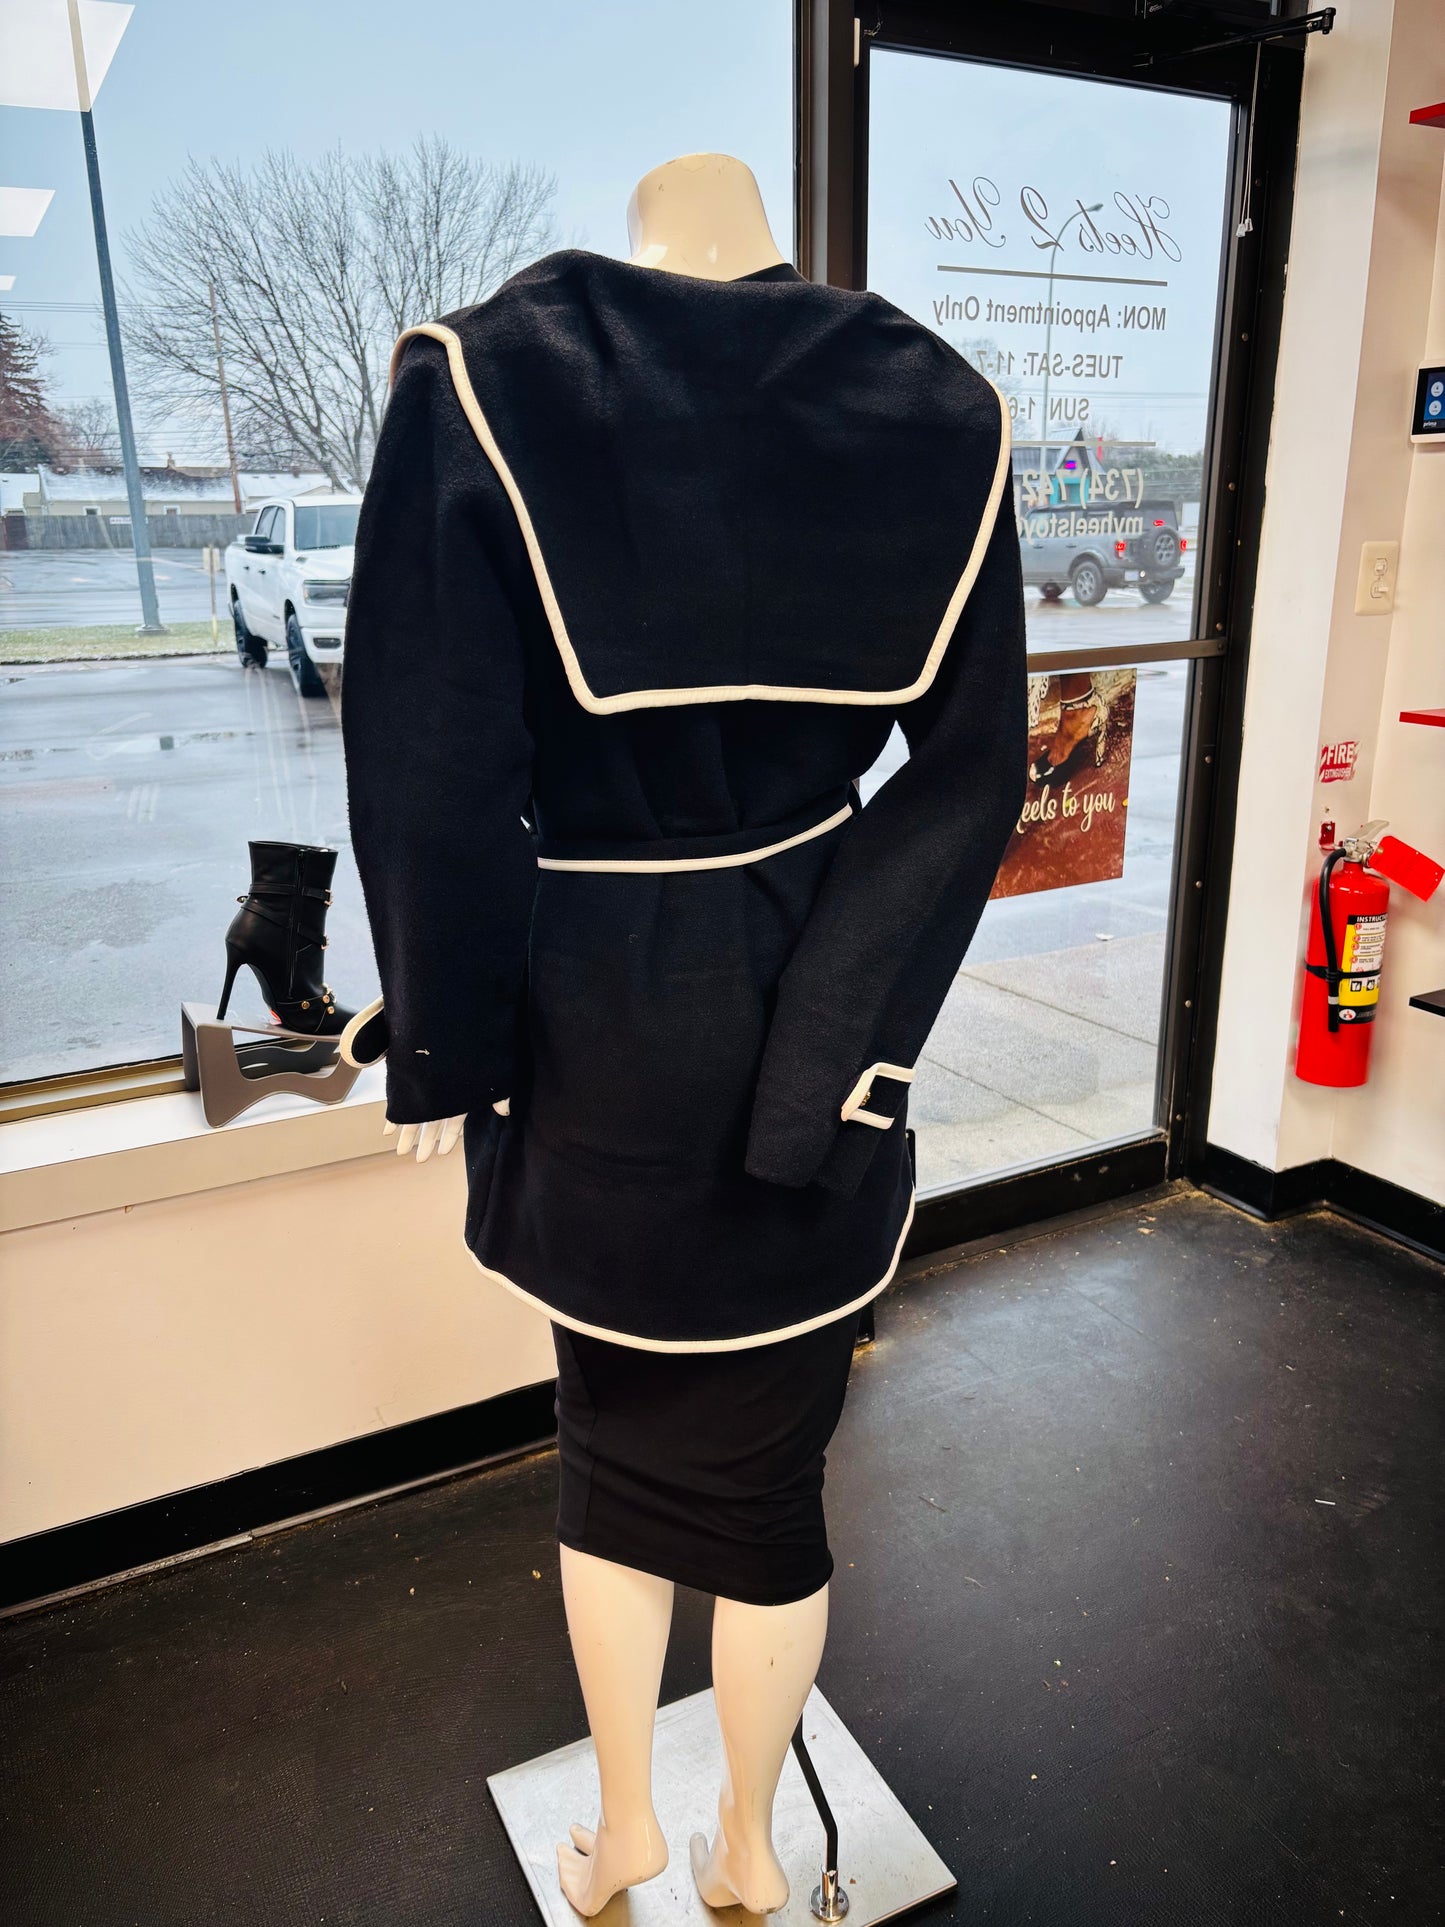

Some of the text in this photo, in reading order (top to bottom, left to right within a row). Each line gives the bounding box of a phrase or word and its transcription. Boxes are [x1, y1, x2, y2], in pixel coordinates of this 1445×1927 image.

[1326, 743, 1355, 766] FIRE
[1016, 781, 1116, 834] eels to you
